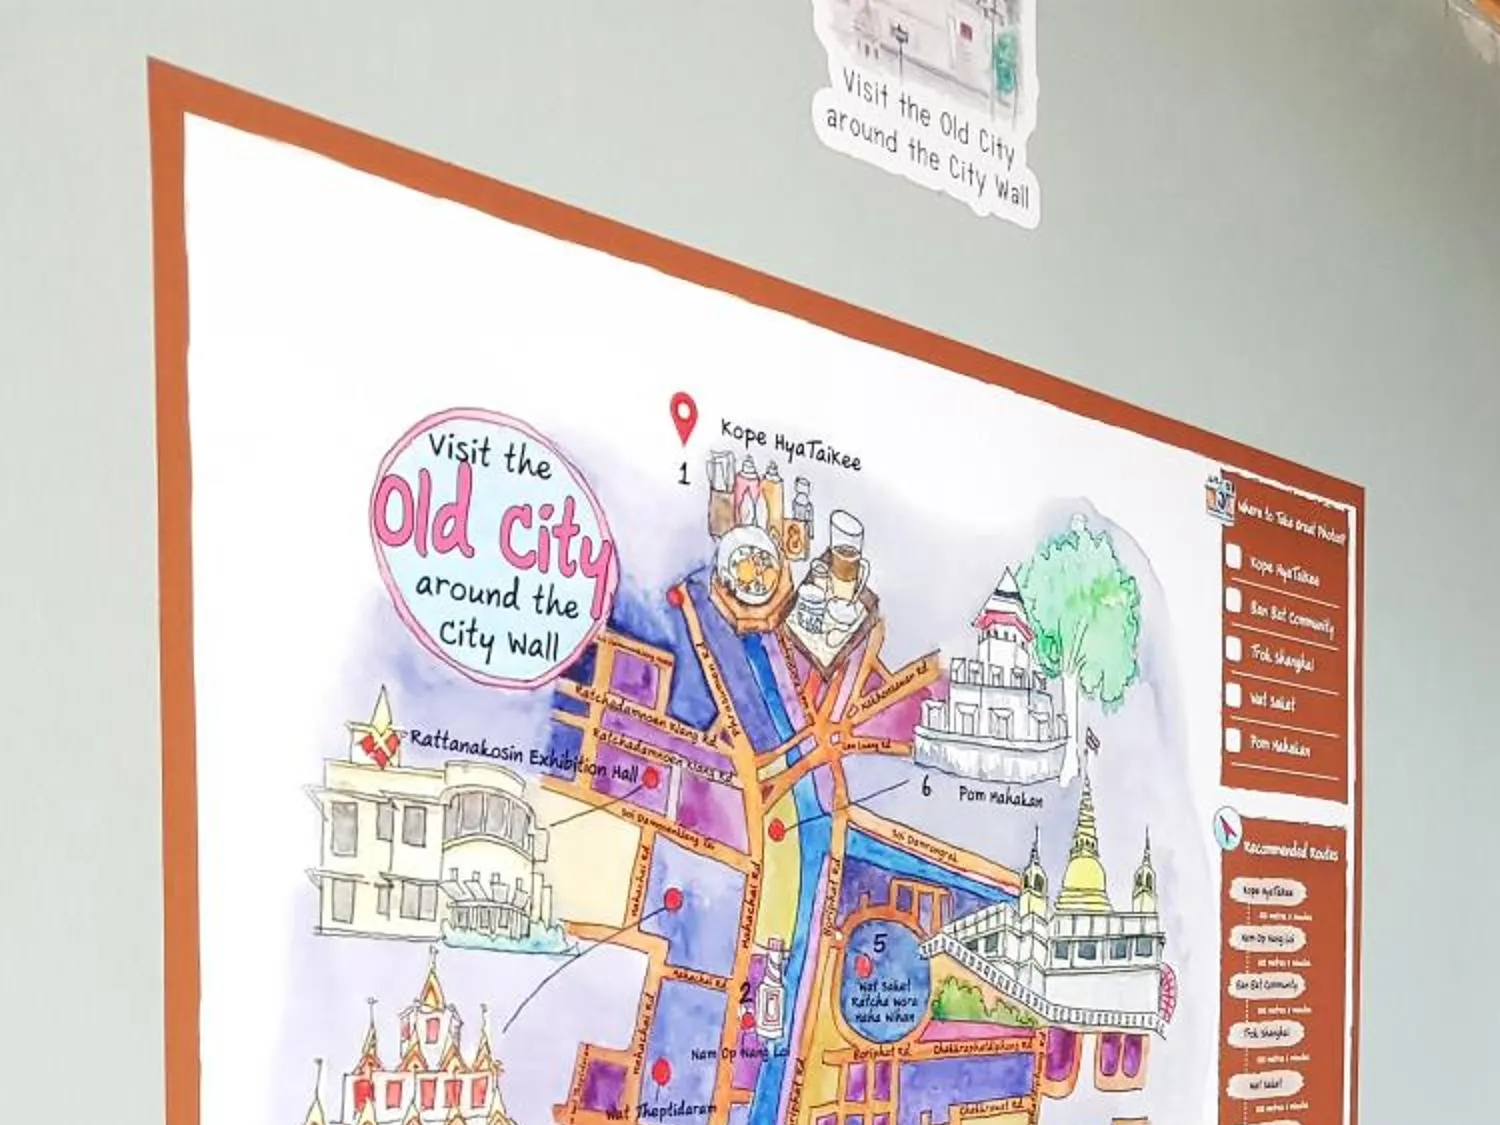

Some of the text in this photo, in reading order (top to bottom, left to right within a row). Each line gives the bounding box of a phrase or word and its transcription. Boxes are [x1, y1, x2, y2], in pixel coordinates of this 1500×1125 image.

[843, 67, 1014, 170] Visit the Old City
[827, 108, 1029, 208] around the City Wall
[428, 433, 552, 479] Visit the
[721, 418, 862, 471] Kope HyaTaikee
[678, 462, 691, 485] 1
[373, 460, 613, 620] Old City
[416, 575, 579, 619] around the
[440, 617, 559, 664] City Wall
[411, 729, 523, 764] Rattanakosin
[530, 749, 608, 776] Exhibition
[922, 775, 931, 797] 6
[959, 785, 986, 802] Pom
[873, 933, 888, 953] 5
[739, 982, 751, 1004] 2
